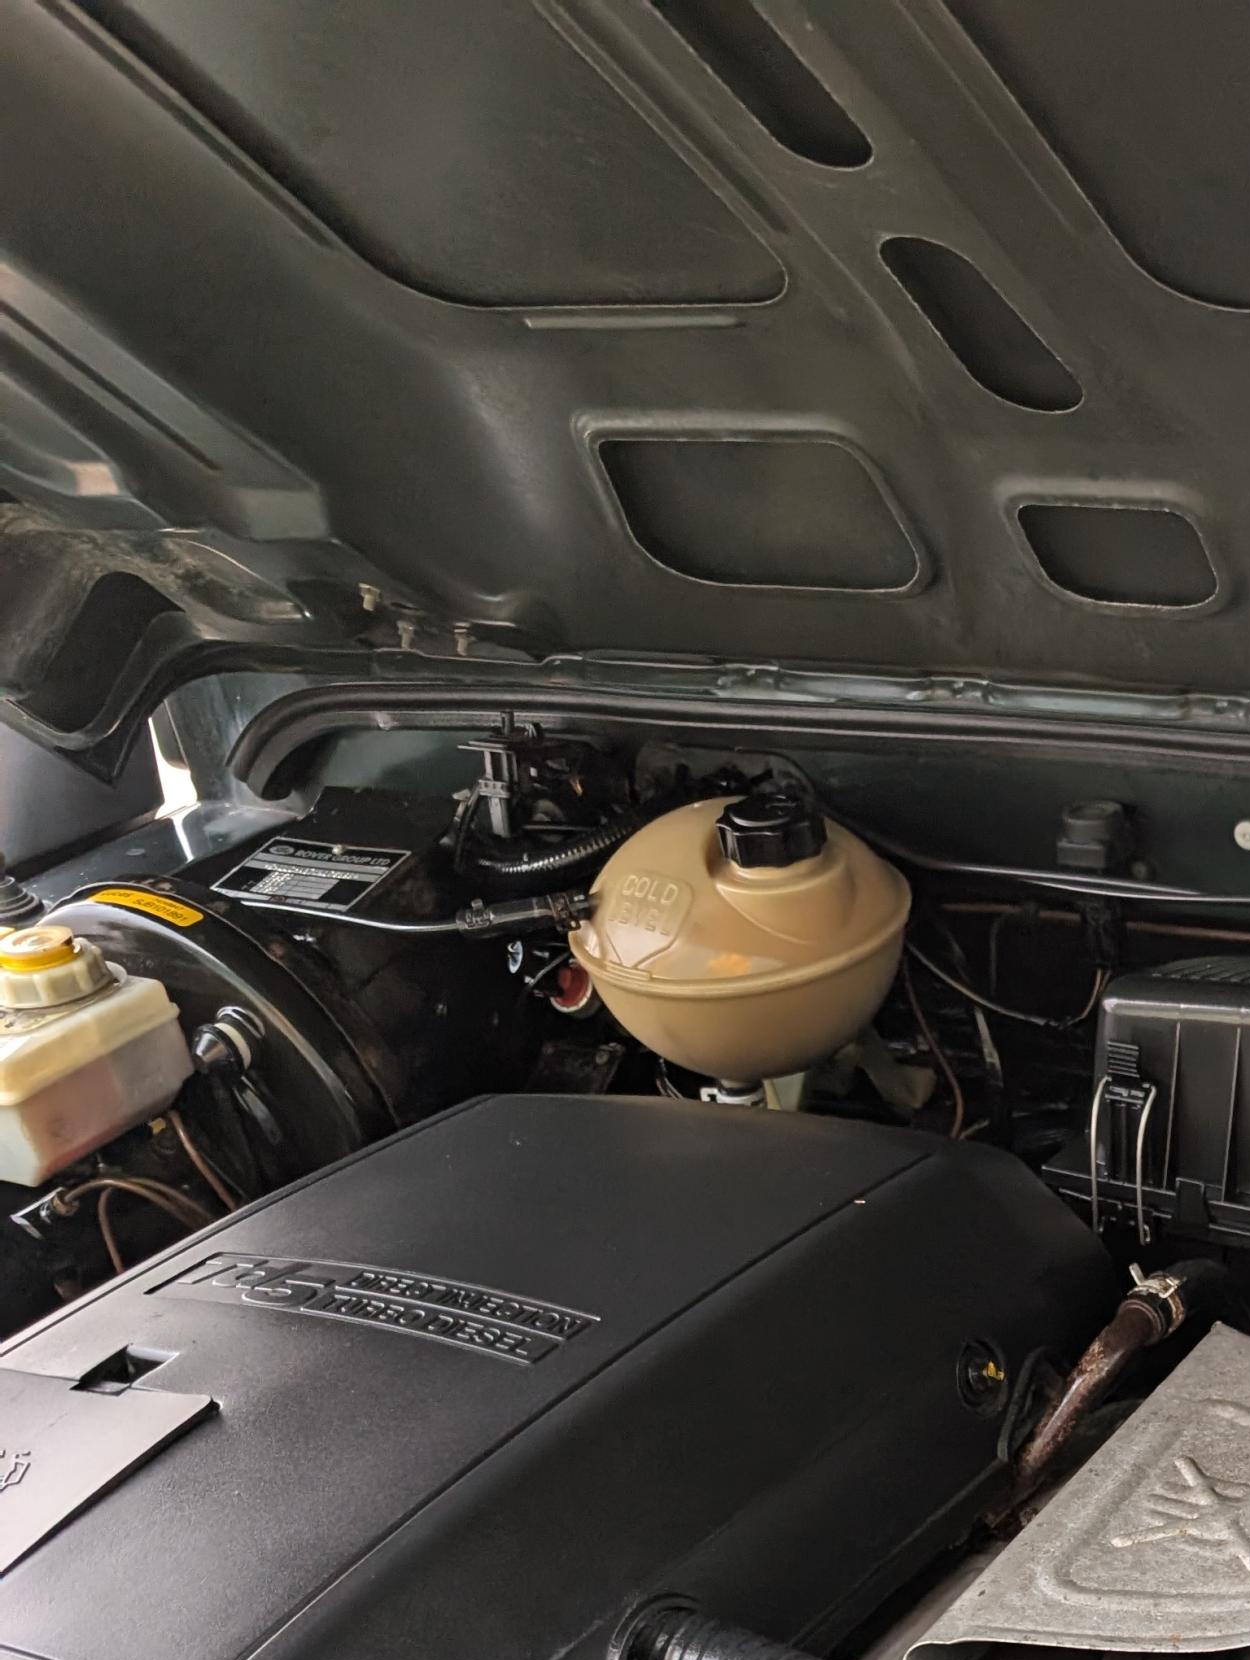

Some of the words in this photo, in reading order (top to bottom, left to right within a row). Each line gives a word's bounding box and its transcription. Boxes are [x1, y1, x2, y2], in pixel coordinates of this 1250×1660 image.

[294, 850, 331, 861] ROVER
[332, 853, 372, 864] GROUP
[622, 875, 679, 904] COLD
[177, 1260, 335, 1306] Td5
[348, 1272, 448, 1303] DIRECT
[440, 1287, 583, 1336] INJECTION
[323, 1294, 426, 1325] TURBO
[425, 1313, 532, 1355] DIESEL
